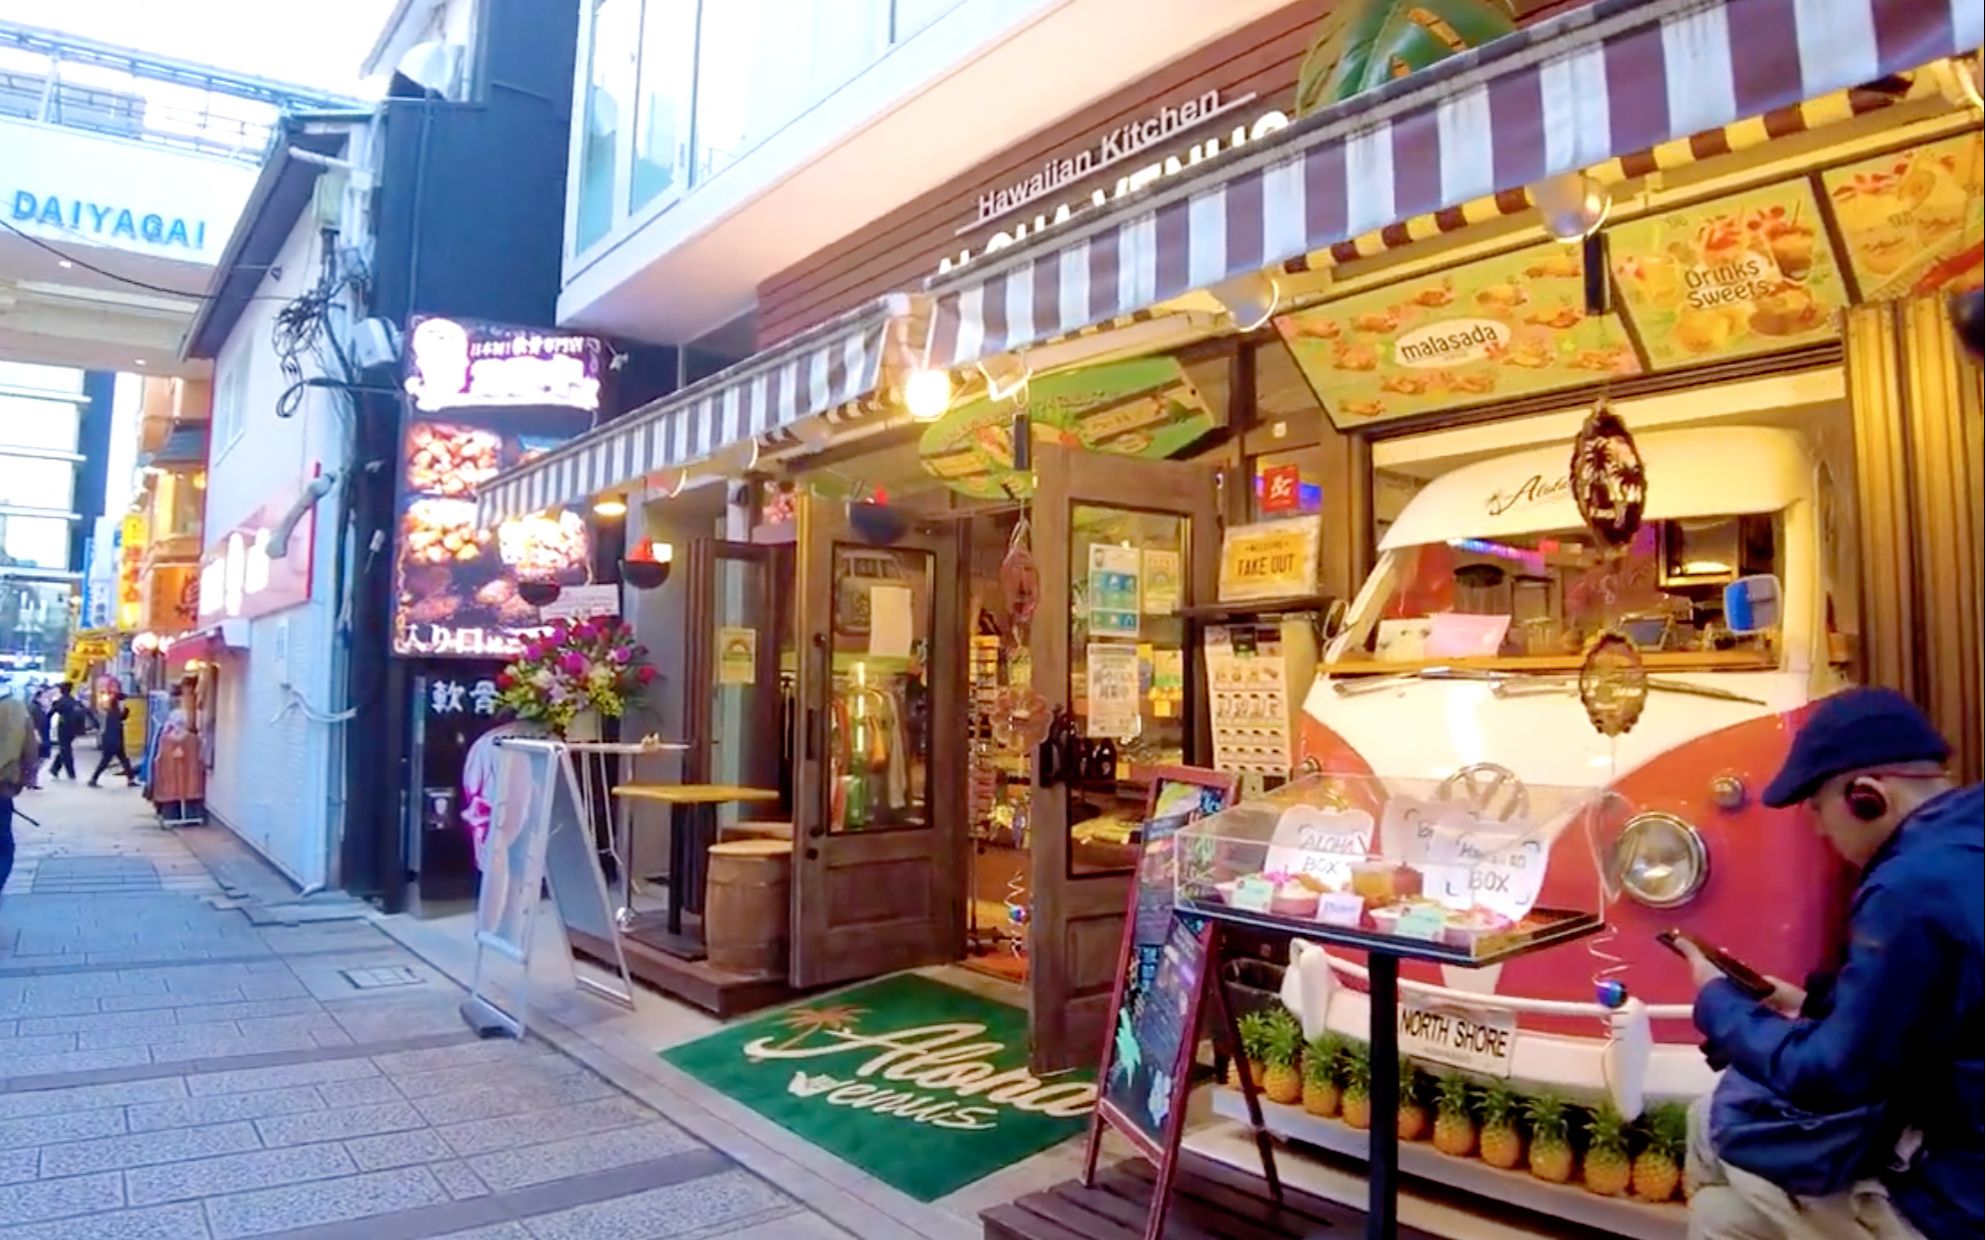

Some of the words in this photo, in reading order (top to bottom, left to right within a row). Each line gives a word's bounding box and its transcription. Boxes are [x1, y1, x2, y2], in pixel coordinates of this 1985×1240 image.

[978, 148, 1092, 219] Hawaiian
[1100, 89, 1220, 163] Kitchen
[12, 188, 207, 250] DAIYAGAI
[1683, 258, 1761, 290] Drinks
[1686, 277, 1772, 310] Sweets
[1400, 323, 1499, 363] malasada
[1237, 556, 1268, 578] TAKE
[1271, 553, 1296, 575] OUT
[431, 679, 501, 715] 軟骨
[1303, 856, 1339, 875] BOX
[1468, 869, 1511, 894] BOX
[1401, 1007, 1450, 1045] NORTH
[1454, 1020, 1510, 1058] SHORE
